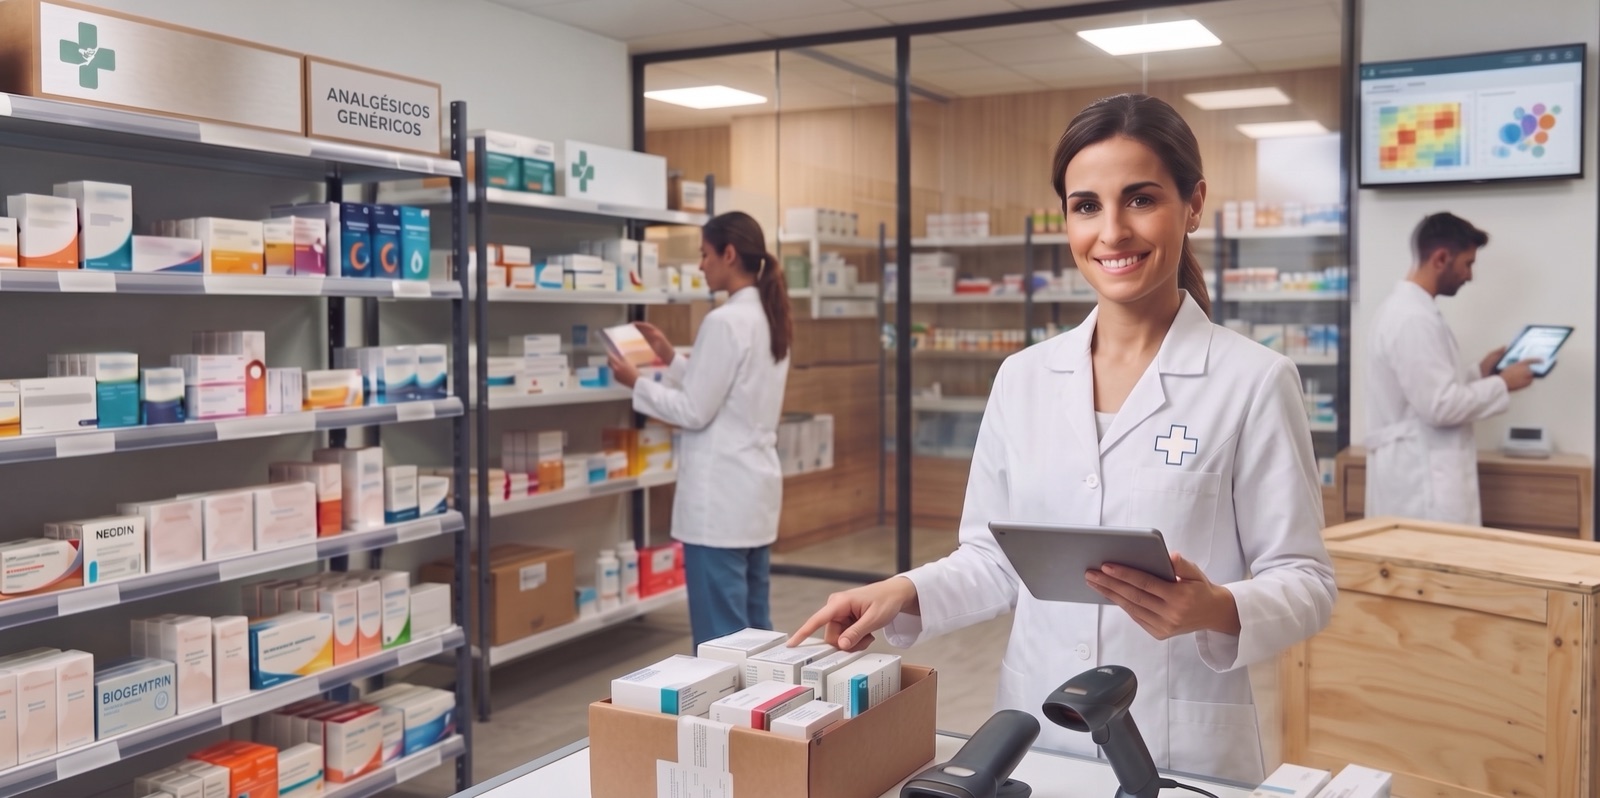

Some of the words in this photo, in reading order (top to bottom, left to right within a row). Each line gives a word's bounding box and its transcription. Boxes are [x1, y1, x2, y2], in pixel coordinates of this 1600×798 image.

[326, 87, 430, 119] ANALGÉSICOS
[337, 109, 422, 136] GENÉRICOS
[96, 525, 134, 540] NEODIN
[103, 675, 171, 705] BIOGEMTRIN
